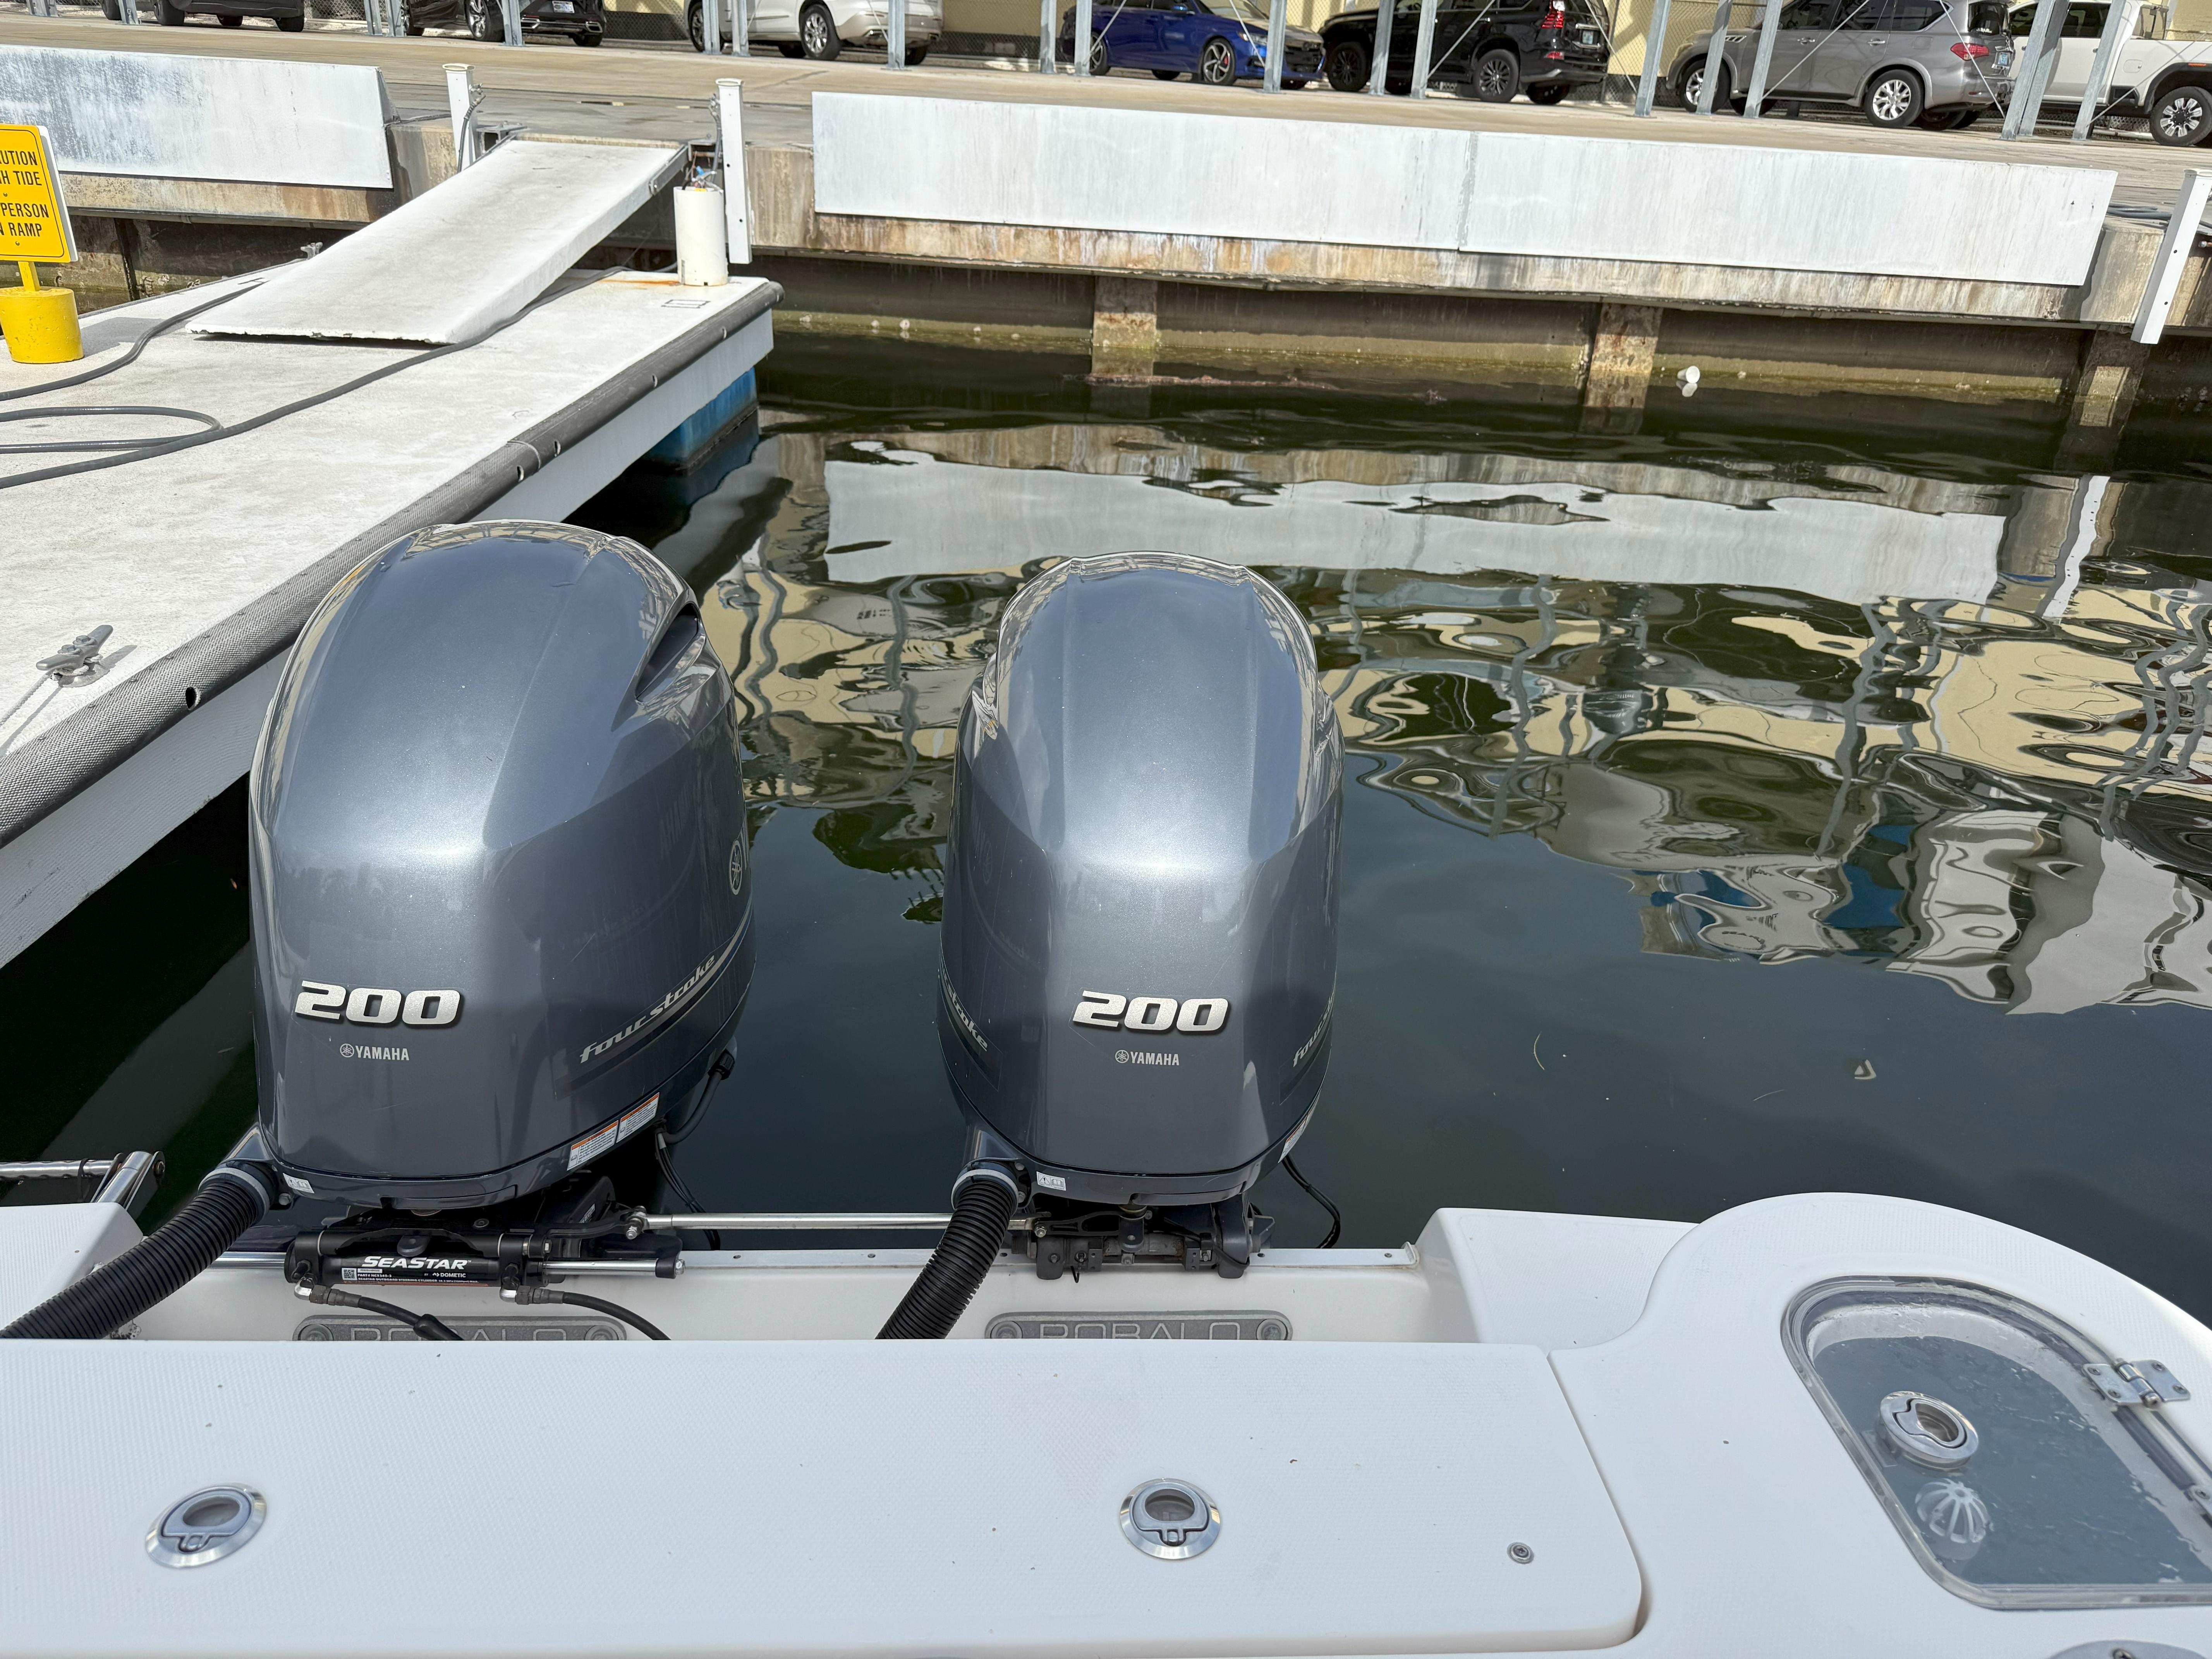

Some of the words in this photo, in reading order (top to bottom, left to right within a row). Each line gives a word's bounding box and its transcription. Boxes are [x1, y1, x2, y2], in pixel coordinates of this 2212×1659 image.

[0, 149, 38, 165] UTION
[0, 170, 10, 184] H
[13, 171, 42, 185] TIDE
[0, 202, 49, 218] PERSON
[8, 222, 42, 237] RAMP
[295, 980, 461, 1025] 200
[1072, 990, 1229, 1032] 200
[355, 1045, 410, 1061] YAMAHA
[1130, 1051, 1180, 1066] YAMAHA
